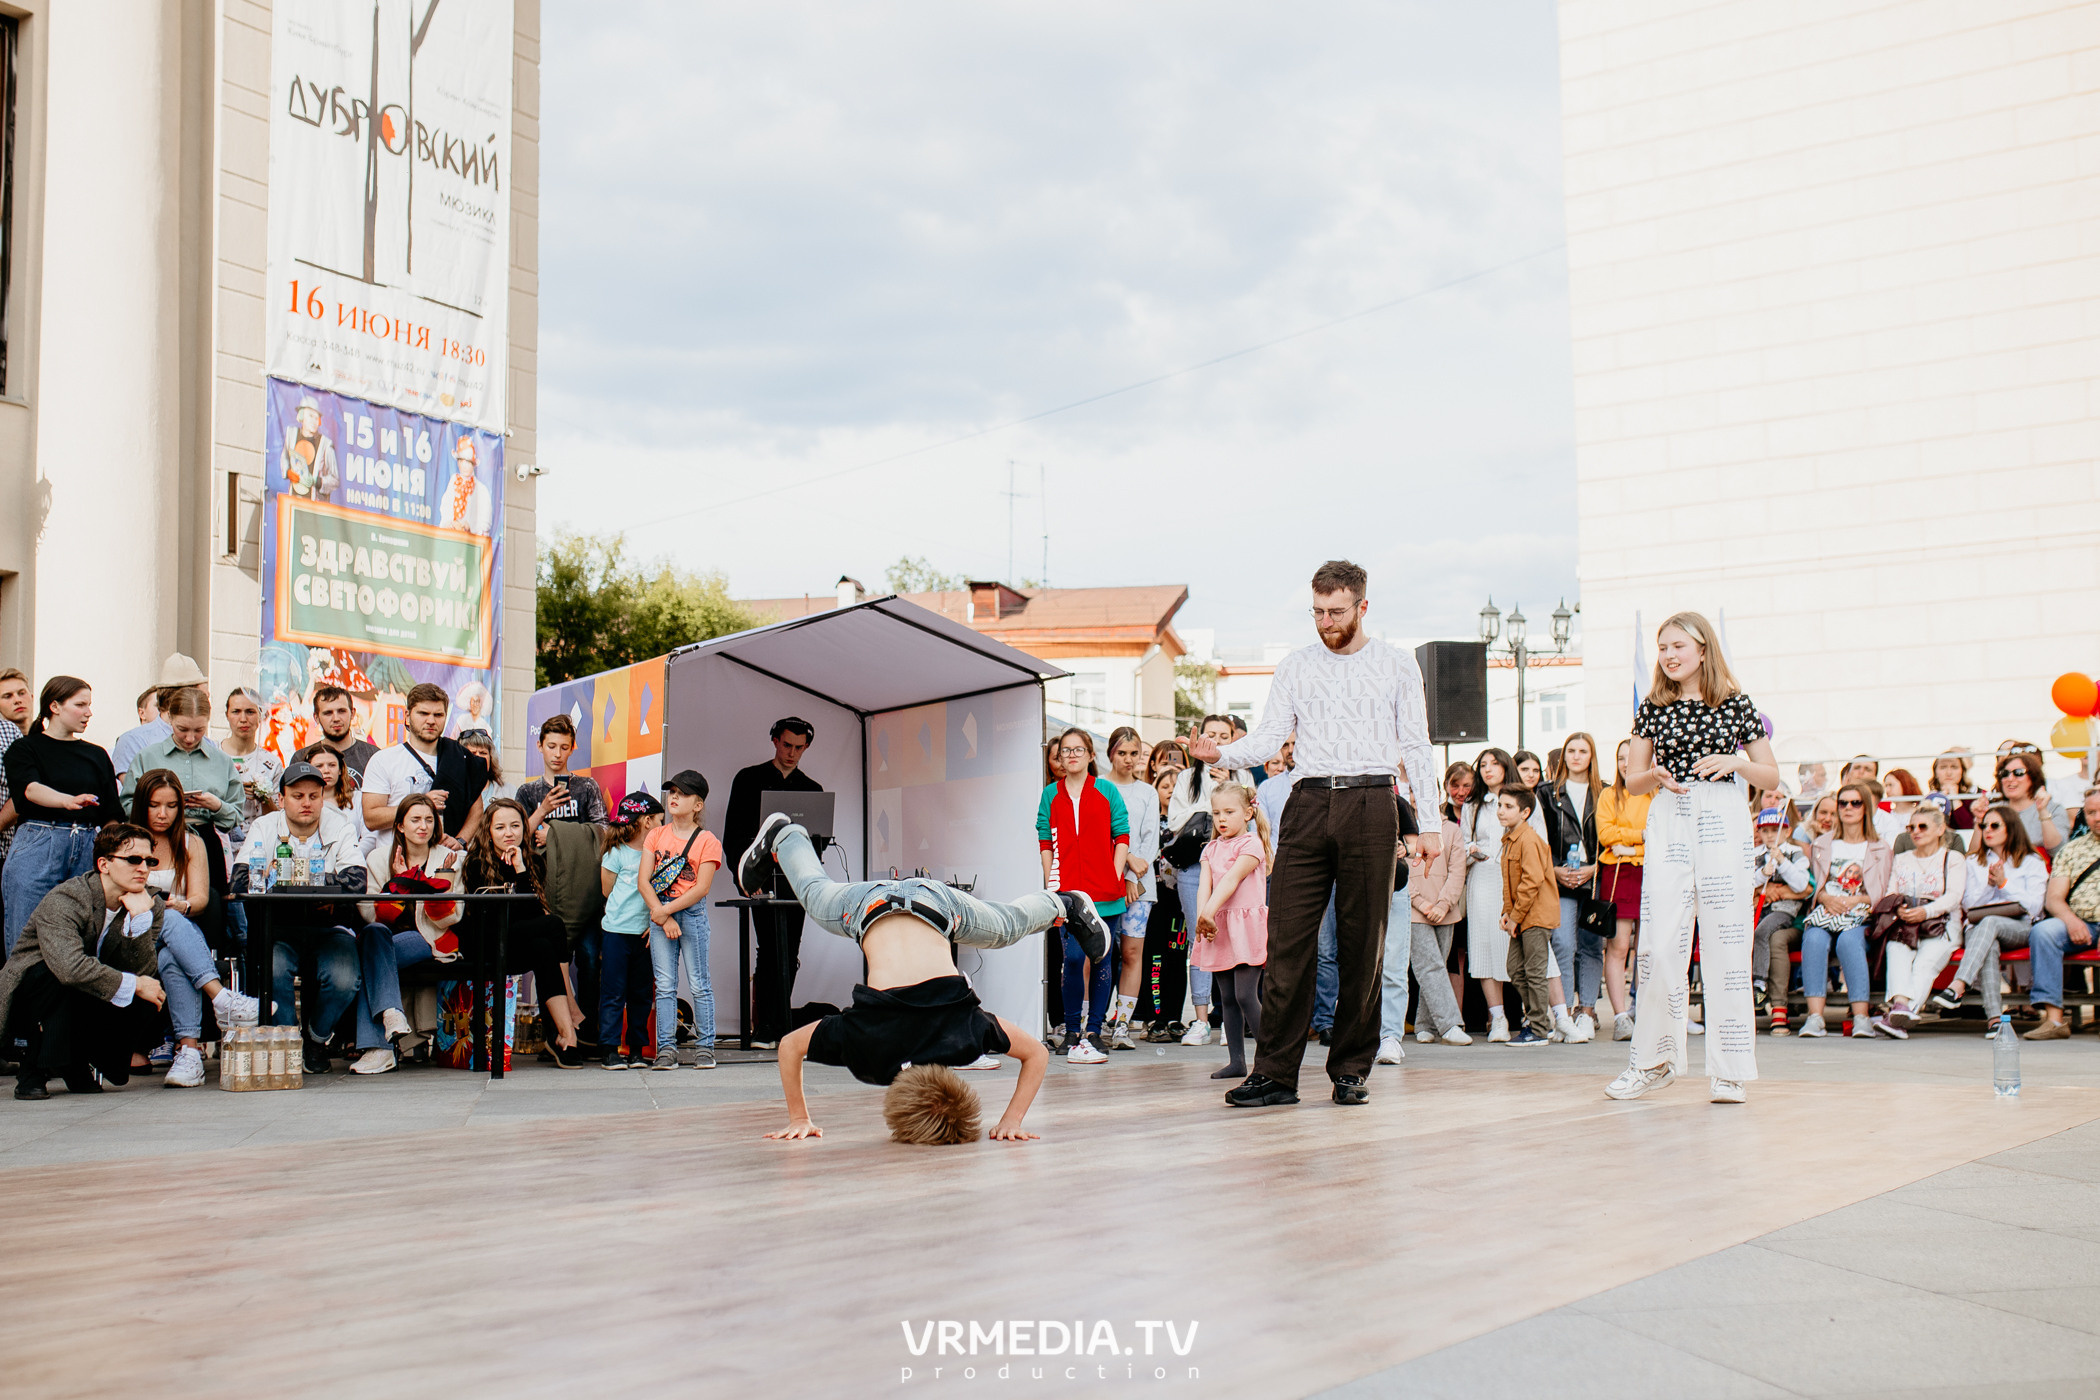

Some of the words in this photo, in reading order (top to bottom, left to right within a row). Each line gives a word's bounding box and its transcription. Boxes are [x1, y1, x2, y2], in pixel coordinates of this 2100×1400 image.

[287, 279, 324, 320] 16
[337, 302, 431, 351] ИЮНЯ
[441, 337, 485, 367] 18:30
[343, 412, 374, 449] 15
[403, 425, 432, 463] 16
[346, 453, 426, 497] ИЮНЯ
[346, 488, 389, 511] НАЧАЛО
[404, 501, 432, 519] 11:00
[300, 534, 474, 600] ЗДРАВСТВУЙ,
[293, 573, 477, 631] СВЕТОФОРИК!
